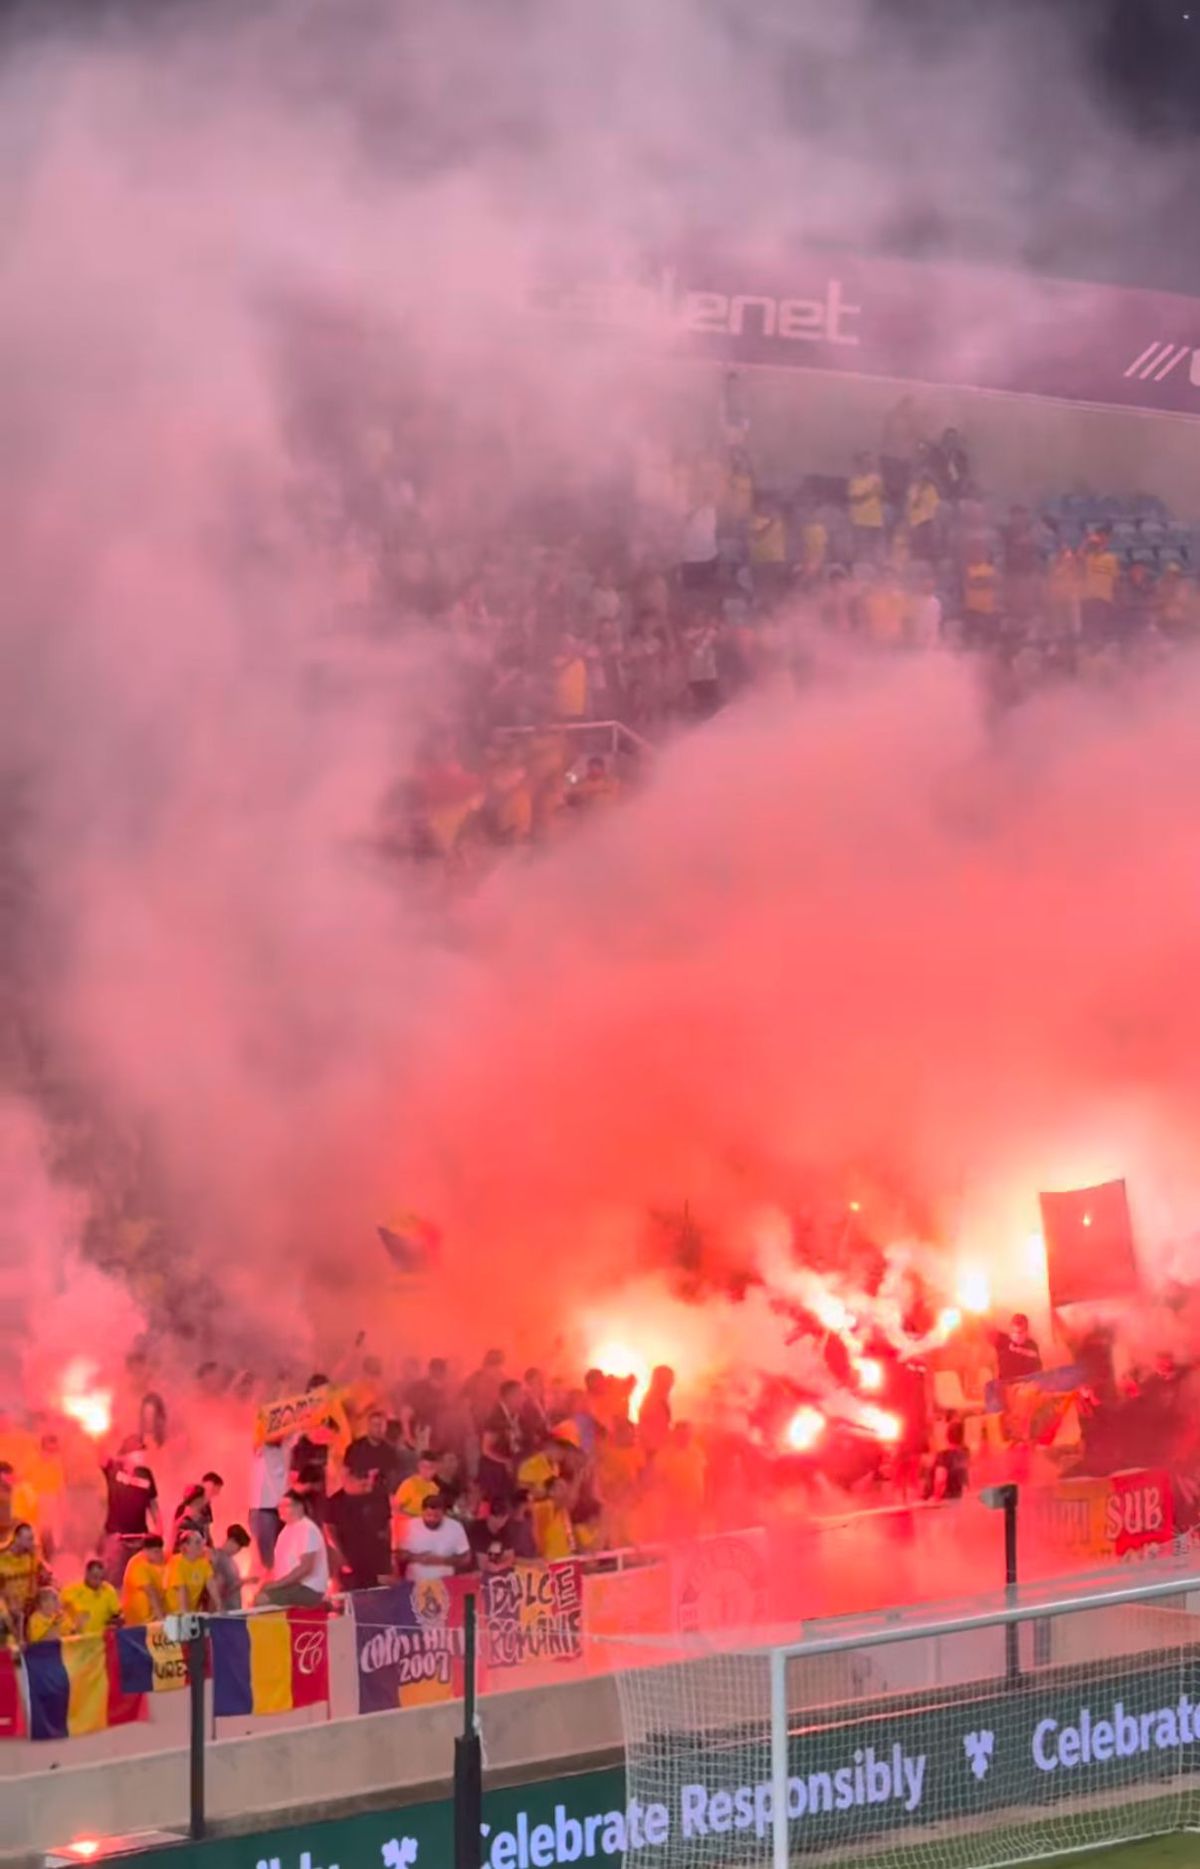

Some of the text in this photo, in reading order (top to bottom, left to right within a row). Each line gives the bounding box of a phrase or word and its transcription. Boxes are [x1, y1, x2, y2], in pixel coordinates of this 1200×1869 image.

[1105, 1487, 1163, 1541] SUB
[489, 1565, 577, 1616] DULCE
[399, 1651, 450, 1684] 2007
[480, 1743, 925, 1869] elebrate Responsibly
